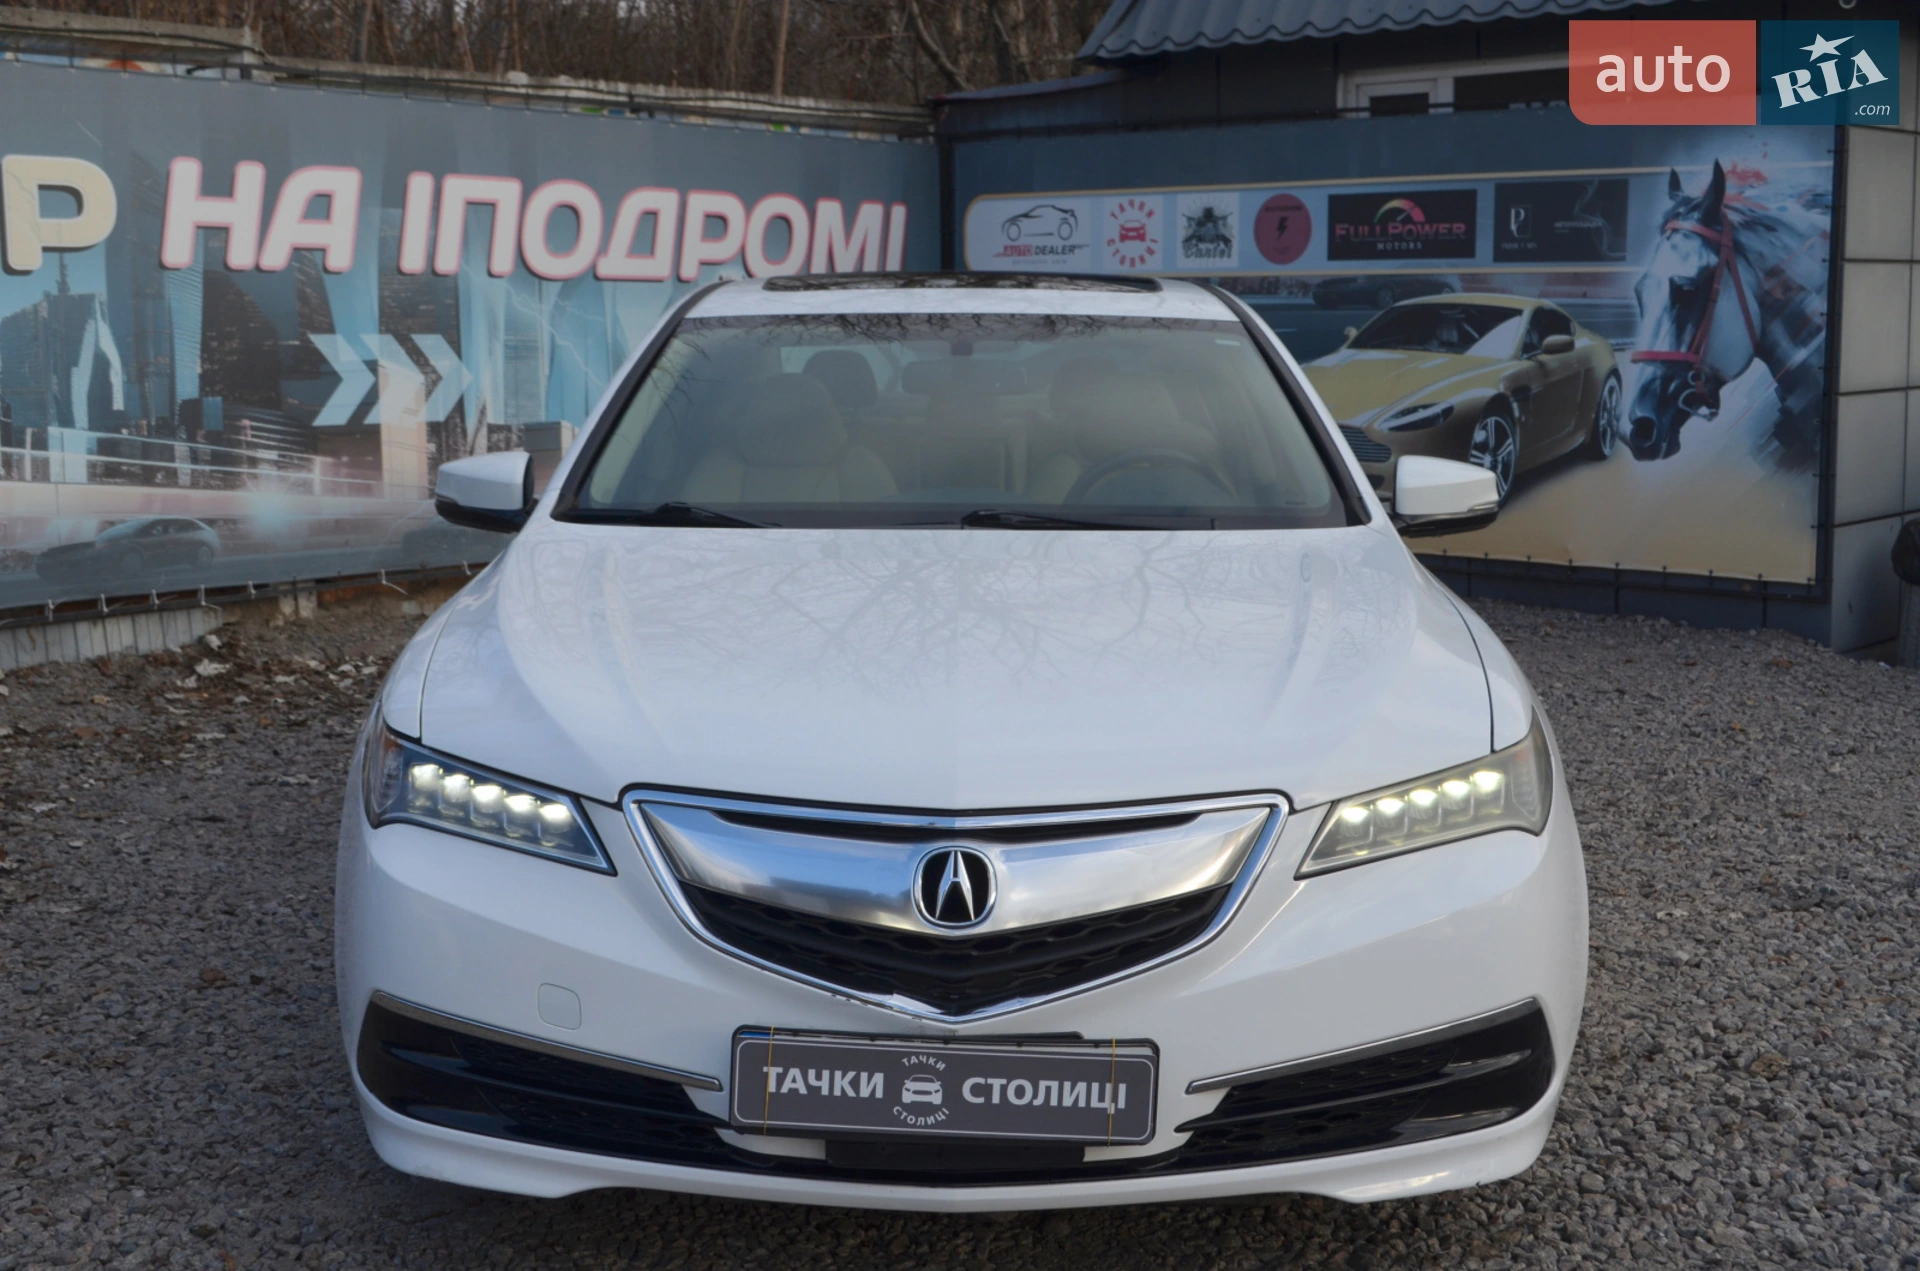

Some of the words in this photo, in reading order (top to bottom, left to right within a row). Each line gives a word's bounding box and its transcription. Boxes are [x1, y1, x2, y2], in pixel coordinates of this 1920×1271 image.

[161, 156, 364, 273] НА
[1034, 244, 1076, 257] DEALER
[1376, 241, 1423, 251] MOTORS
[902, 1054, 946, 1071] ТАЧКИ
[763, 1066, 885, 1099] ТАЧКИ
[962, 1077, 1128, 1115] СТОЛИЦІ
[893, 1105, 950, 1127] СТОЛИЦІ
